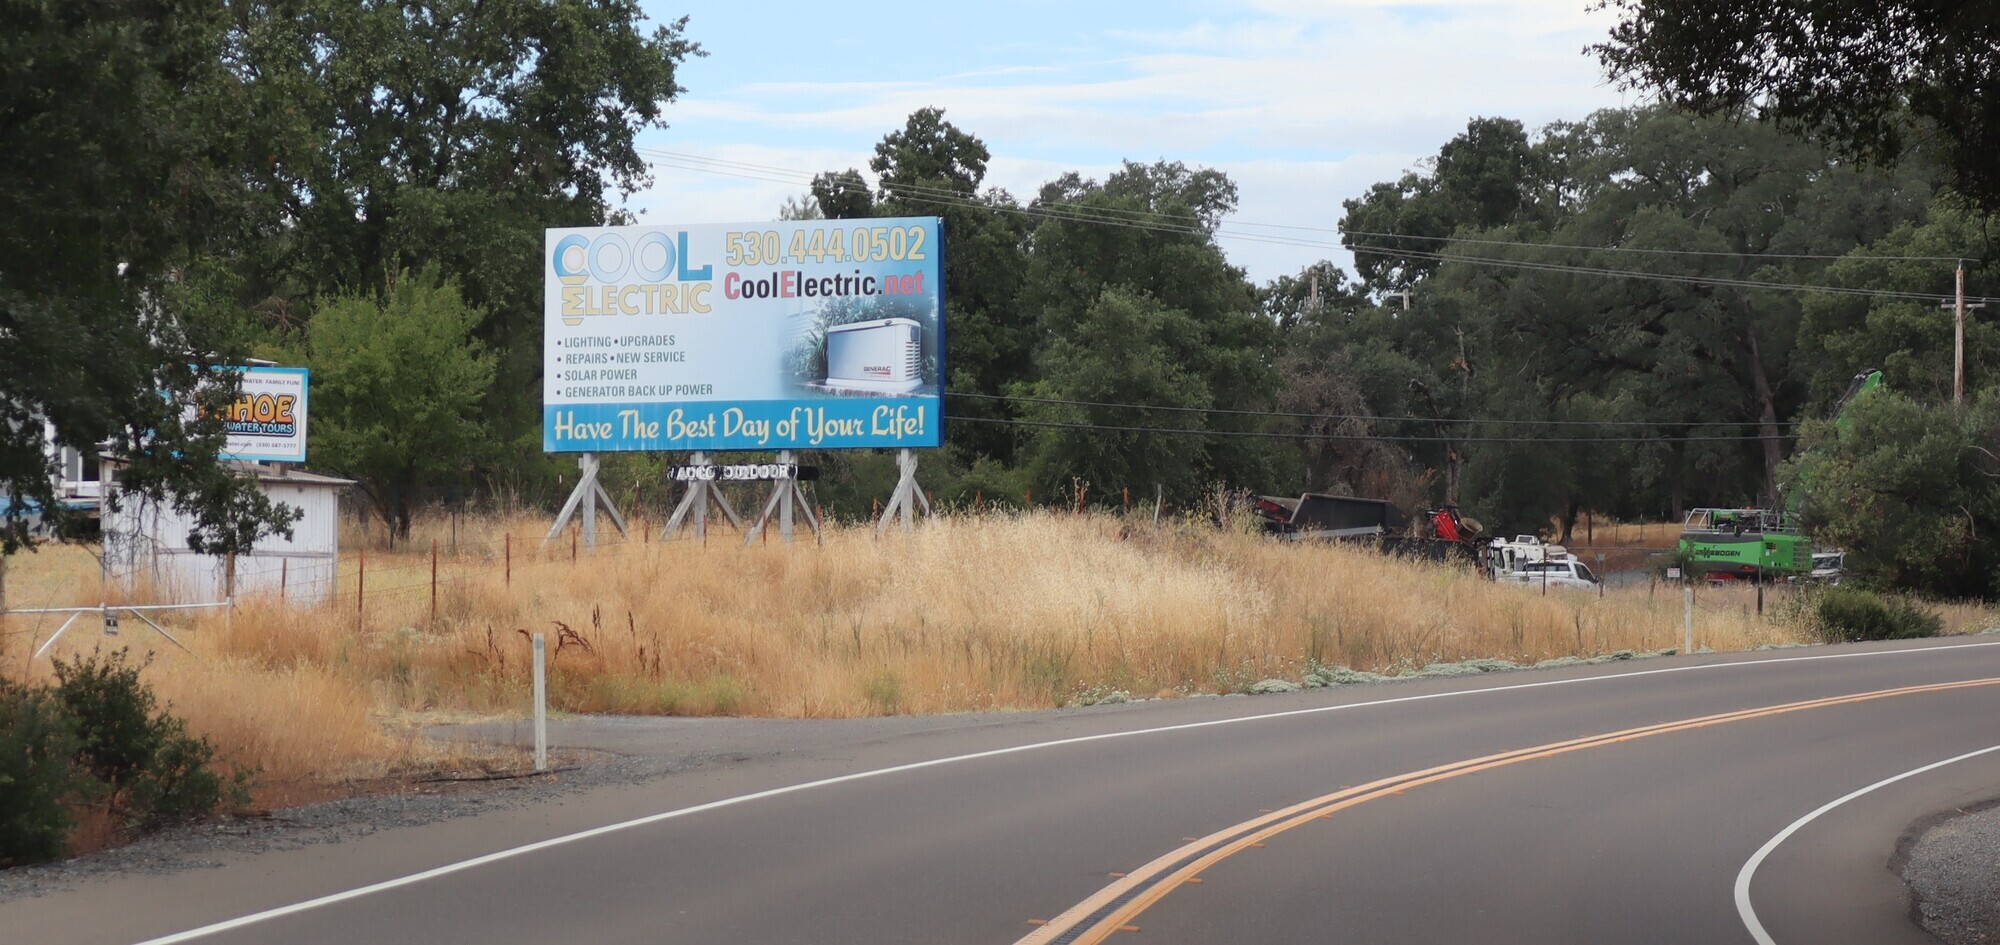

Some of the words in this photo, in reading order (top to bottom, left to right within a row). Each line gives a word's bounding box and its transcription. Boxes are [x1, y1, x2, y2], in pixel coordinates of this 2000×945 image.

[725, 225, 926, 266] 530.444.0502
[553, 231, 712, 284] COOL
[724, 269, 925, 300] CoolElectric.net
[561, 282, 713, 317] ELECTRIC
[564, 336, 612, 348] LIGHTING
[620, 335, 675, 347] UPGRADES
[565, 352, 608, 364] REPAIRS
[616, 352, 641, 363] NEW
[643, 351, 686, 363] SERVICE
[564, 369, 597, 381] SOLAR
[600, 369, 637, 380] POWER
[565, 386, 625, 398] GENERATOR
[628, 385, 656, 396] BACK
[658, 384, 673, 396] UP
[675, 384, 713, 395] POWER
[225, 422, 260, 432] WATER
[261, 423, 293, 433] TOURS
[554, 410, 613, 441] Have
[617, 408, 660, 439] The
[666, 408, 716, 441] Best
[722, 407, 770, 445] Day
[775, 406, 802, 442] of
[804, 406, 865, 445] Your
[871, 404, 925, 440] Life!
